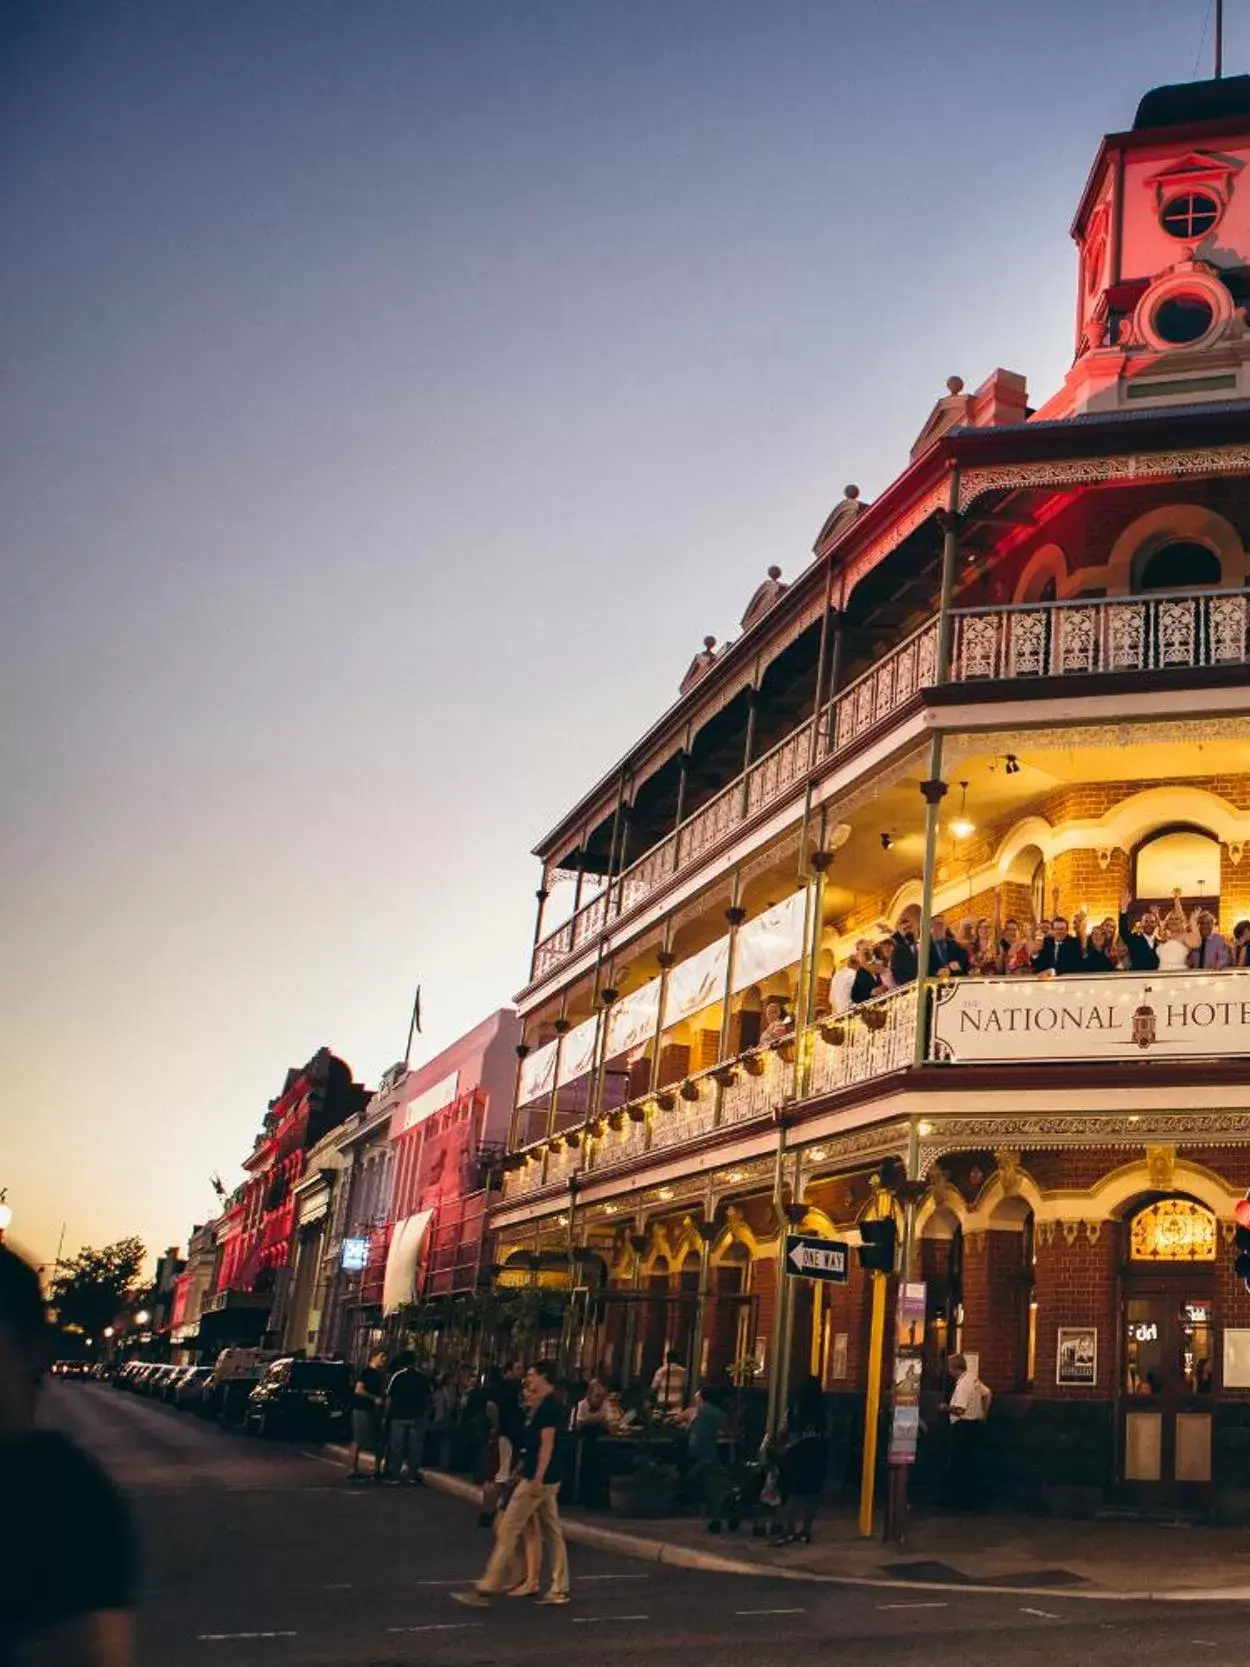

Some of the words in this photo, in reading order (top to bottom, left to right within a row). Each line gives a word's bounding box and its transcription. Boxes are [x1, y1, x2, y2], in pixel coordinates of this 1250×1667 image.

[960, 1005, 1123, 1032] NATIONAL
[803, 1250, 820, 1266] ONE
[824, 1252, 842, 1268] WAY
